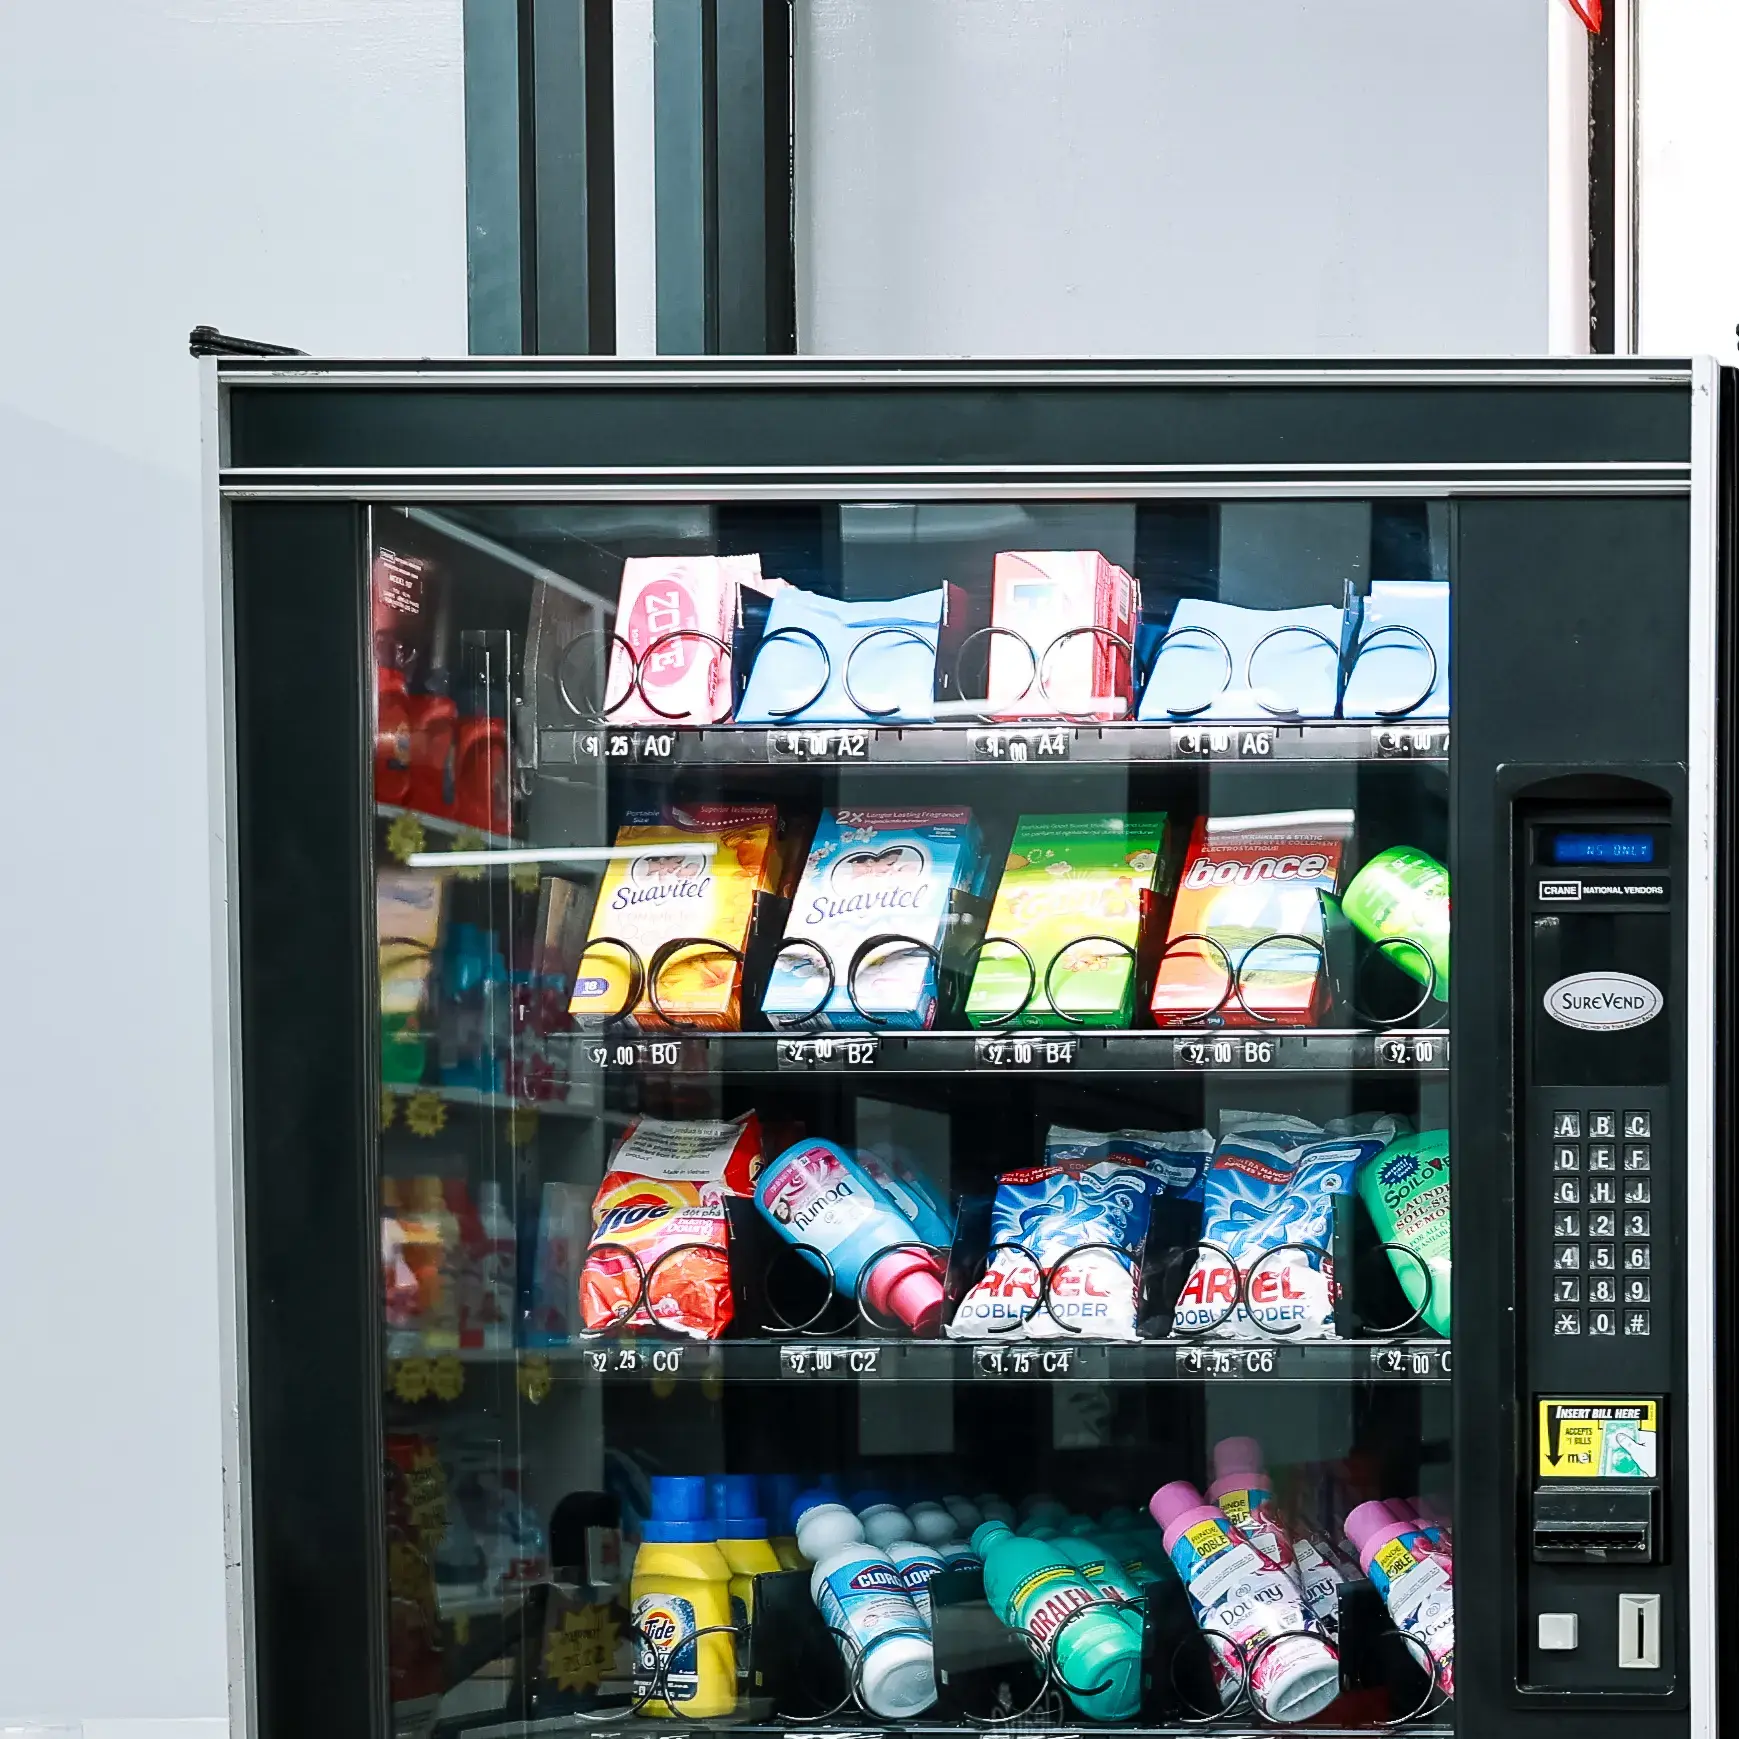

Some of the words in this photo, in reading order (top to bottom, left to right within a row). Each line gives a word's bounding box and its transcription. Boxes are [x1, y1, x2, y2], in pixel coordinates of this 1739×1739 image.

[1184, 854, 1328, 890] bounce
[612, 877, 710, 911] Suavitel
[1544, 886, 1577, 896] CRANE
[805, 883, 930, 925] Suavitel
[1245, 1041, 1271, 1063] B6
[653, 1350, 679, 1372] C0
[1556, 1406, 1590, 1418] INSERT
[1592, 1409, 1612, 1418] BILL
[1615, 1409, 1641, 1418] HERE
[1568, 1450, 1591, 1463] mei
[1219, 1583, 1283, 1625] Downy
[644, 1620, 676, 1643] Tide
